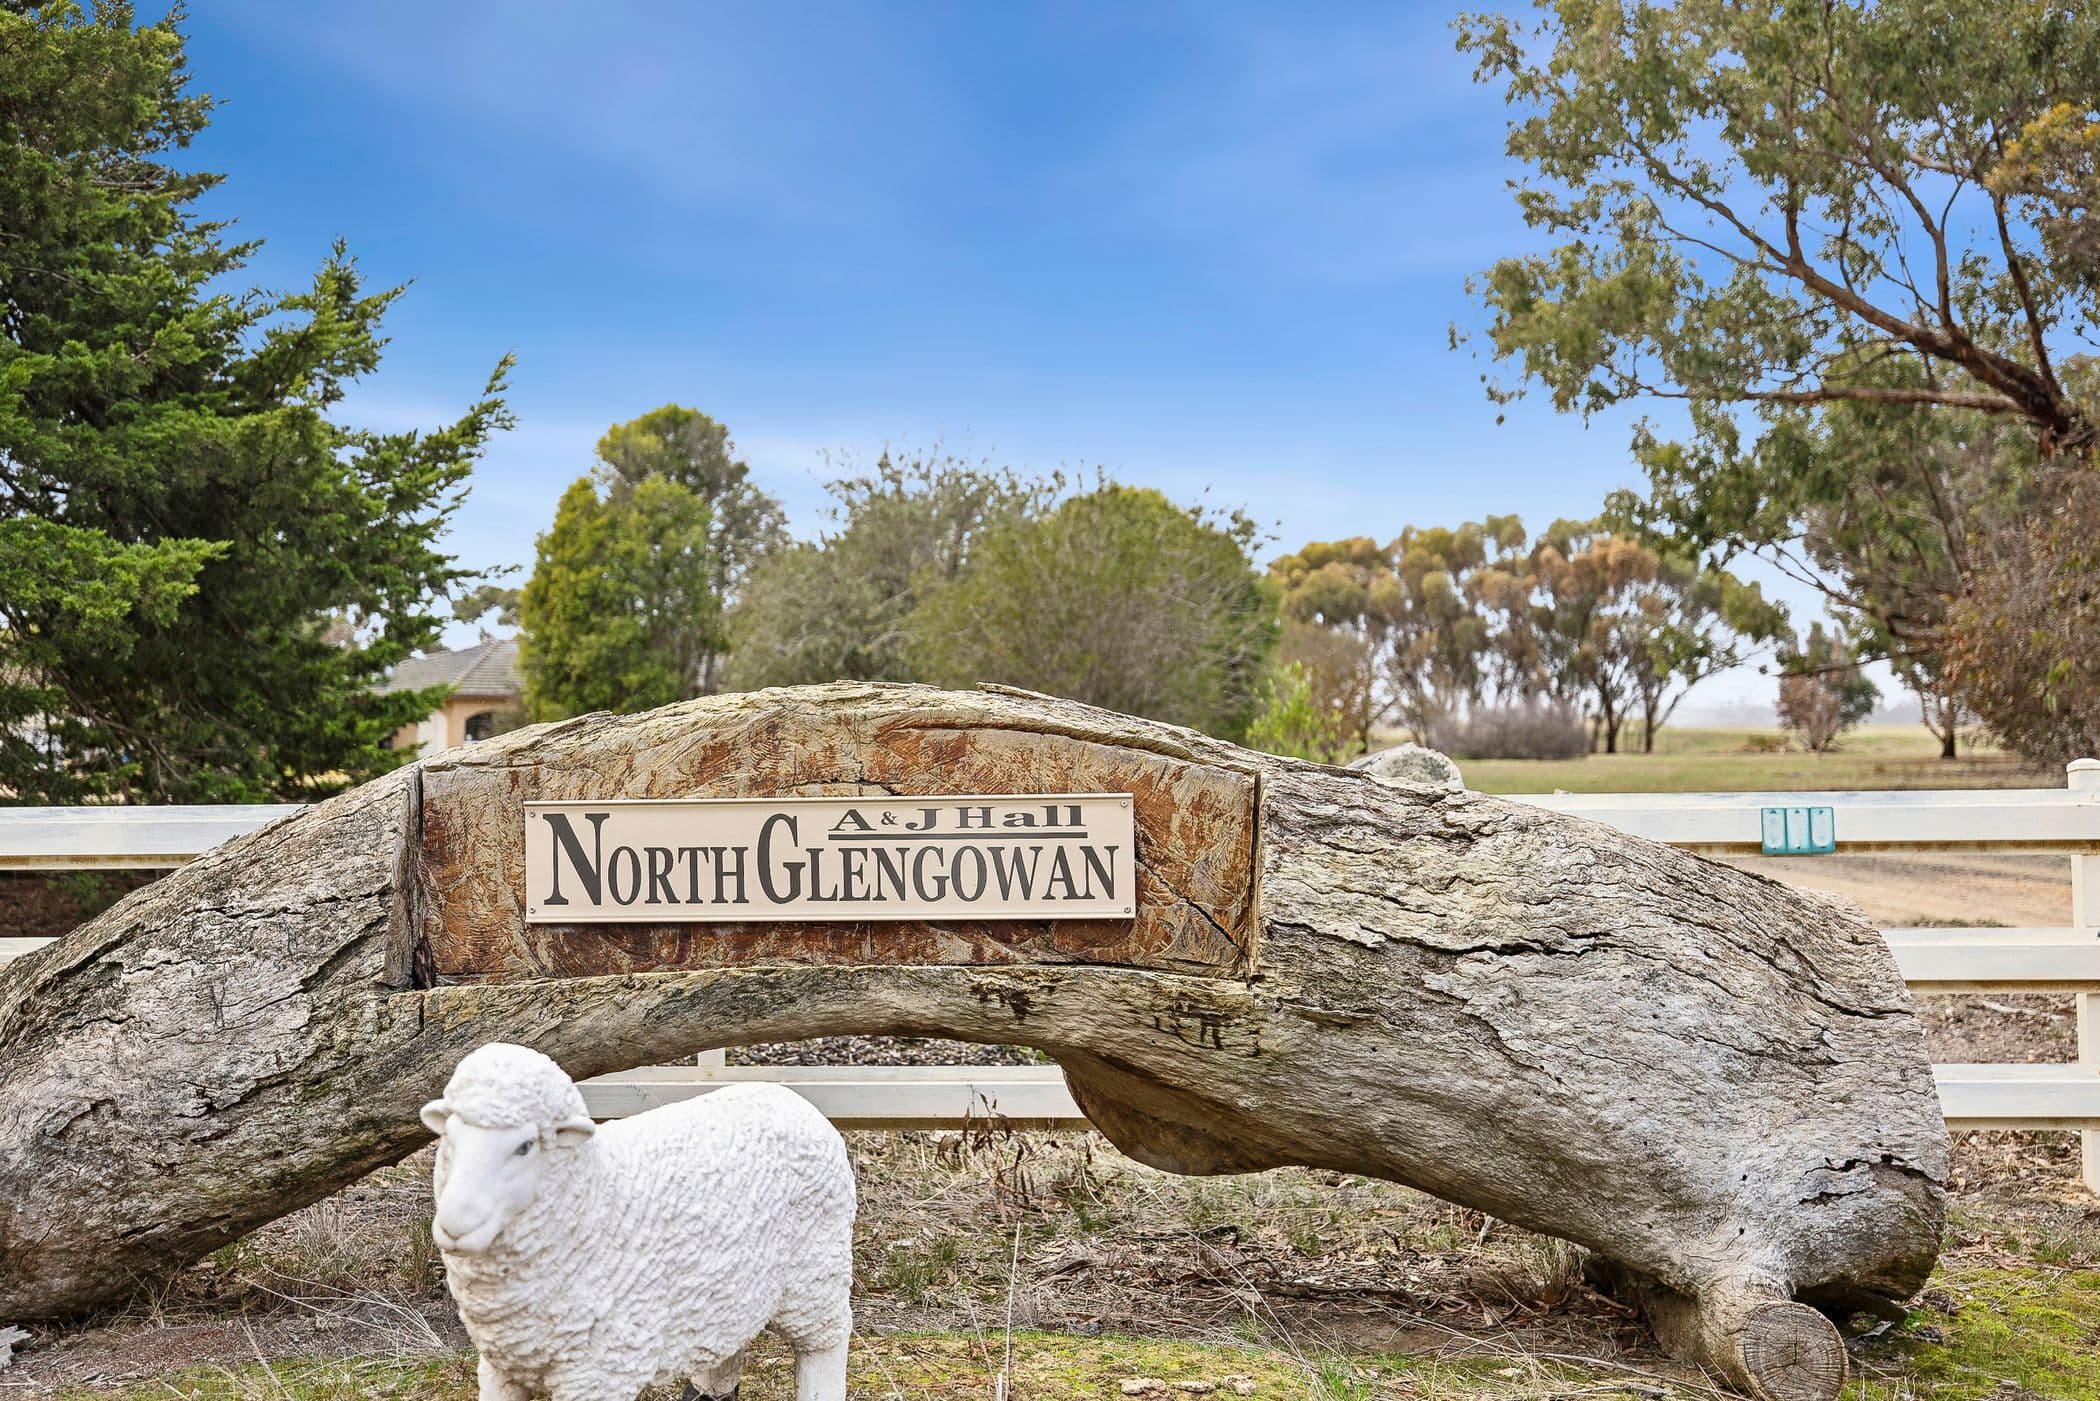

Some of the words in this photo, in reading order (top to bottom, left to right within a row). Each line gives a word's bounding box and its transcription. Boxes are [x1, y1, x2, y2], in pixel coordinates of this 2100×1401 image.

[954, 804, 1088, 829] Hall
[543, 812, 750, 906] NORTH
[756, 813, 1120, 905] GLENGOWAN
